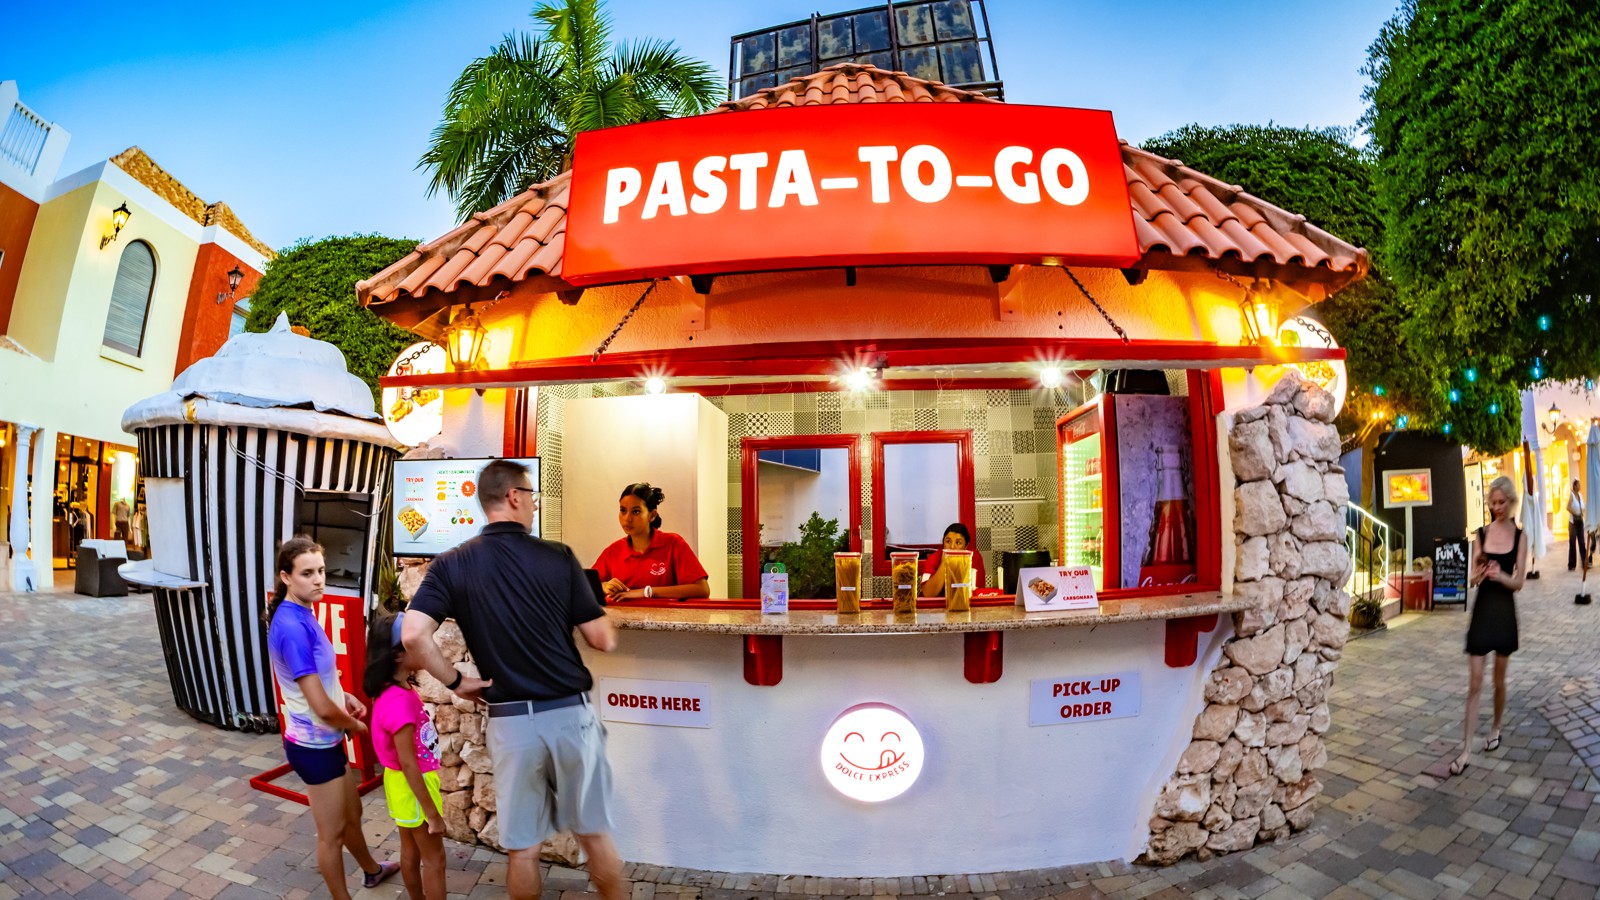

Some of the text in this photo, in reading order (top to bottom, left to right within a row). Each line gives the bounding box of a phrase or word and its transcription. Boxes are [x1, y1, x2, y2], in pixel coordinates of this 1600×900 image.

[1435, 546, 1454, 561] FUN
[1073, 569, 1089, 577] OUR
[1052, 678, 1121, 697] PICK-UP
[607, 692, 701, 712] ORDER HERE
[1060, 701, 1112, 719] ORDER
[835, 760, 910, 782] DOLCE EXPRESS
